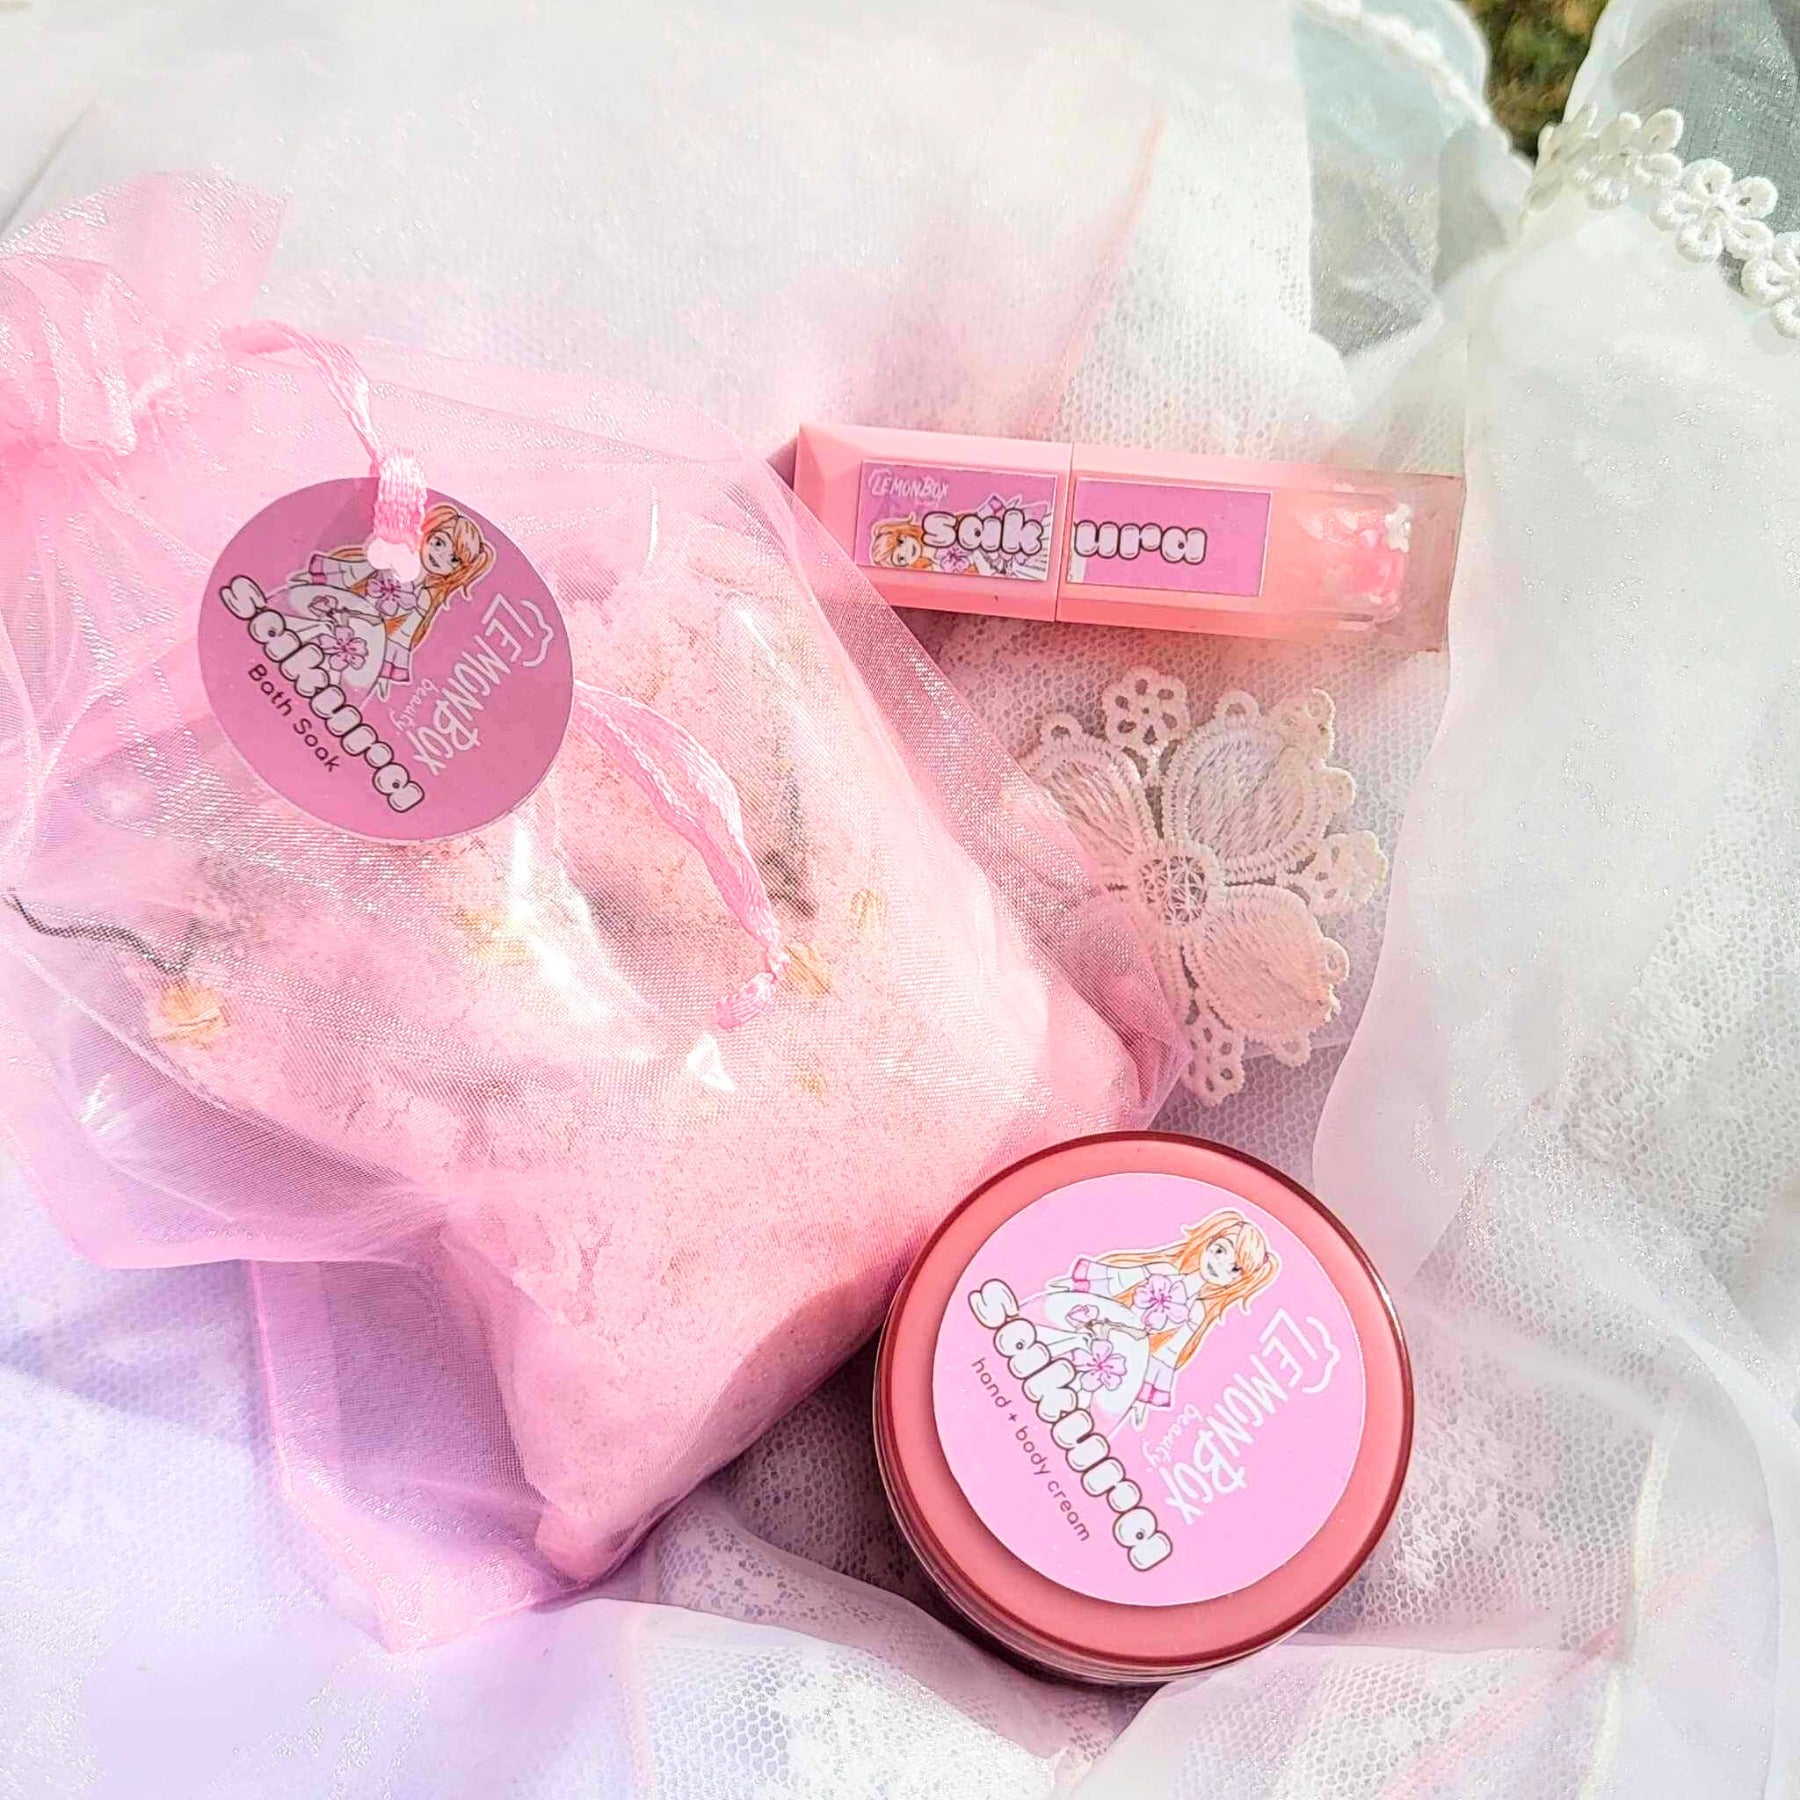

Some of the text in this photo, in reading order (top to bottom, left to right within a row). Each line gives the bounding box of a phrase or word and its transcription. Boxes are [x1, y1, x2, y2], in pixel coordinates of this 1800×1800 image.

[219, 575, 425, 813] sakura
[248, 662, 341, 773] Bath Soak
[389, 677, 442, 735] beauty
[968, 1278, 1173, 1571] sakura
[971, 1357, 1090, 1542] hand + body cream
[1144, 1403, 1202, 1468] beauty
